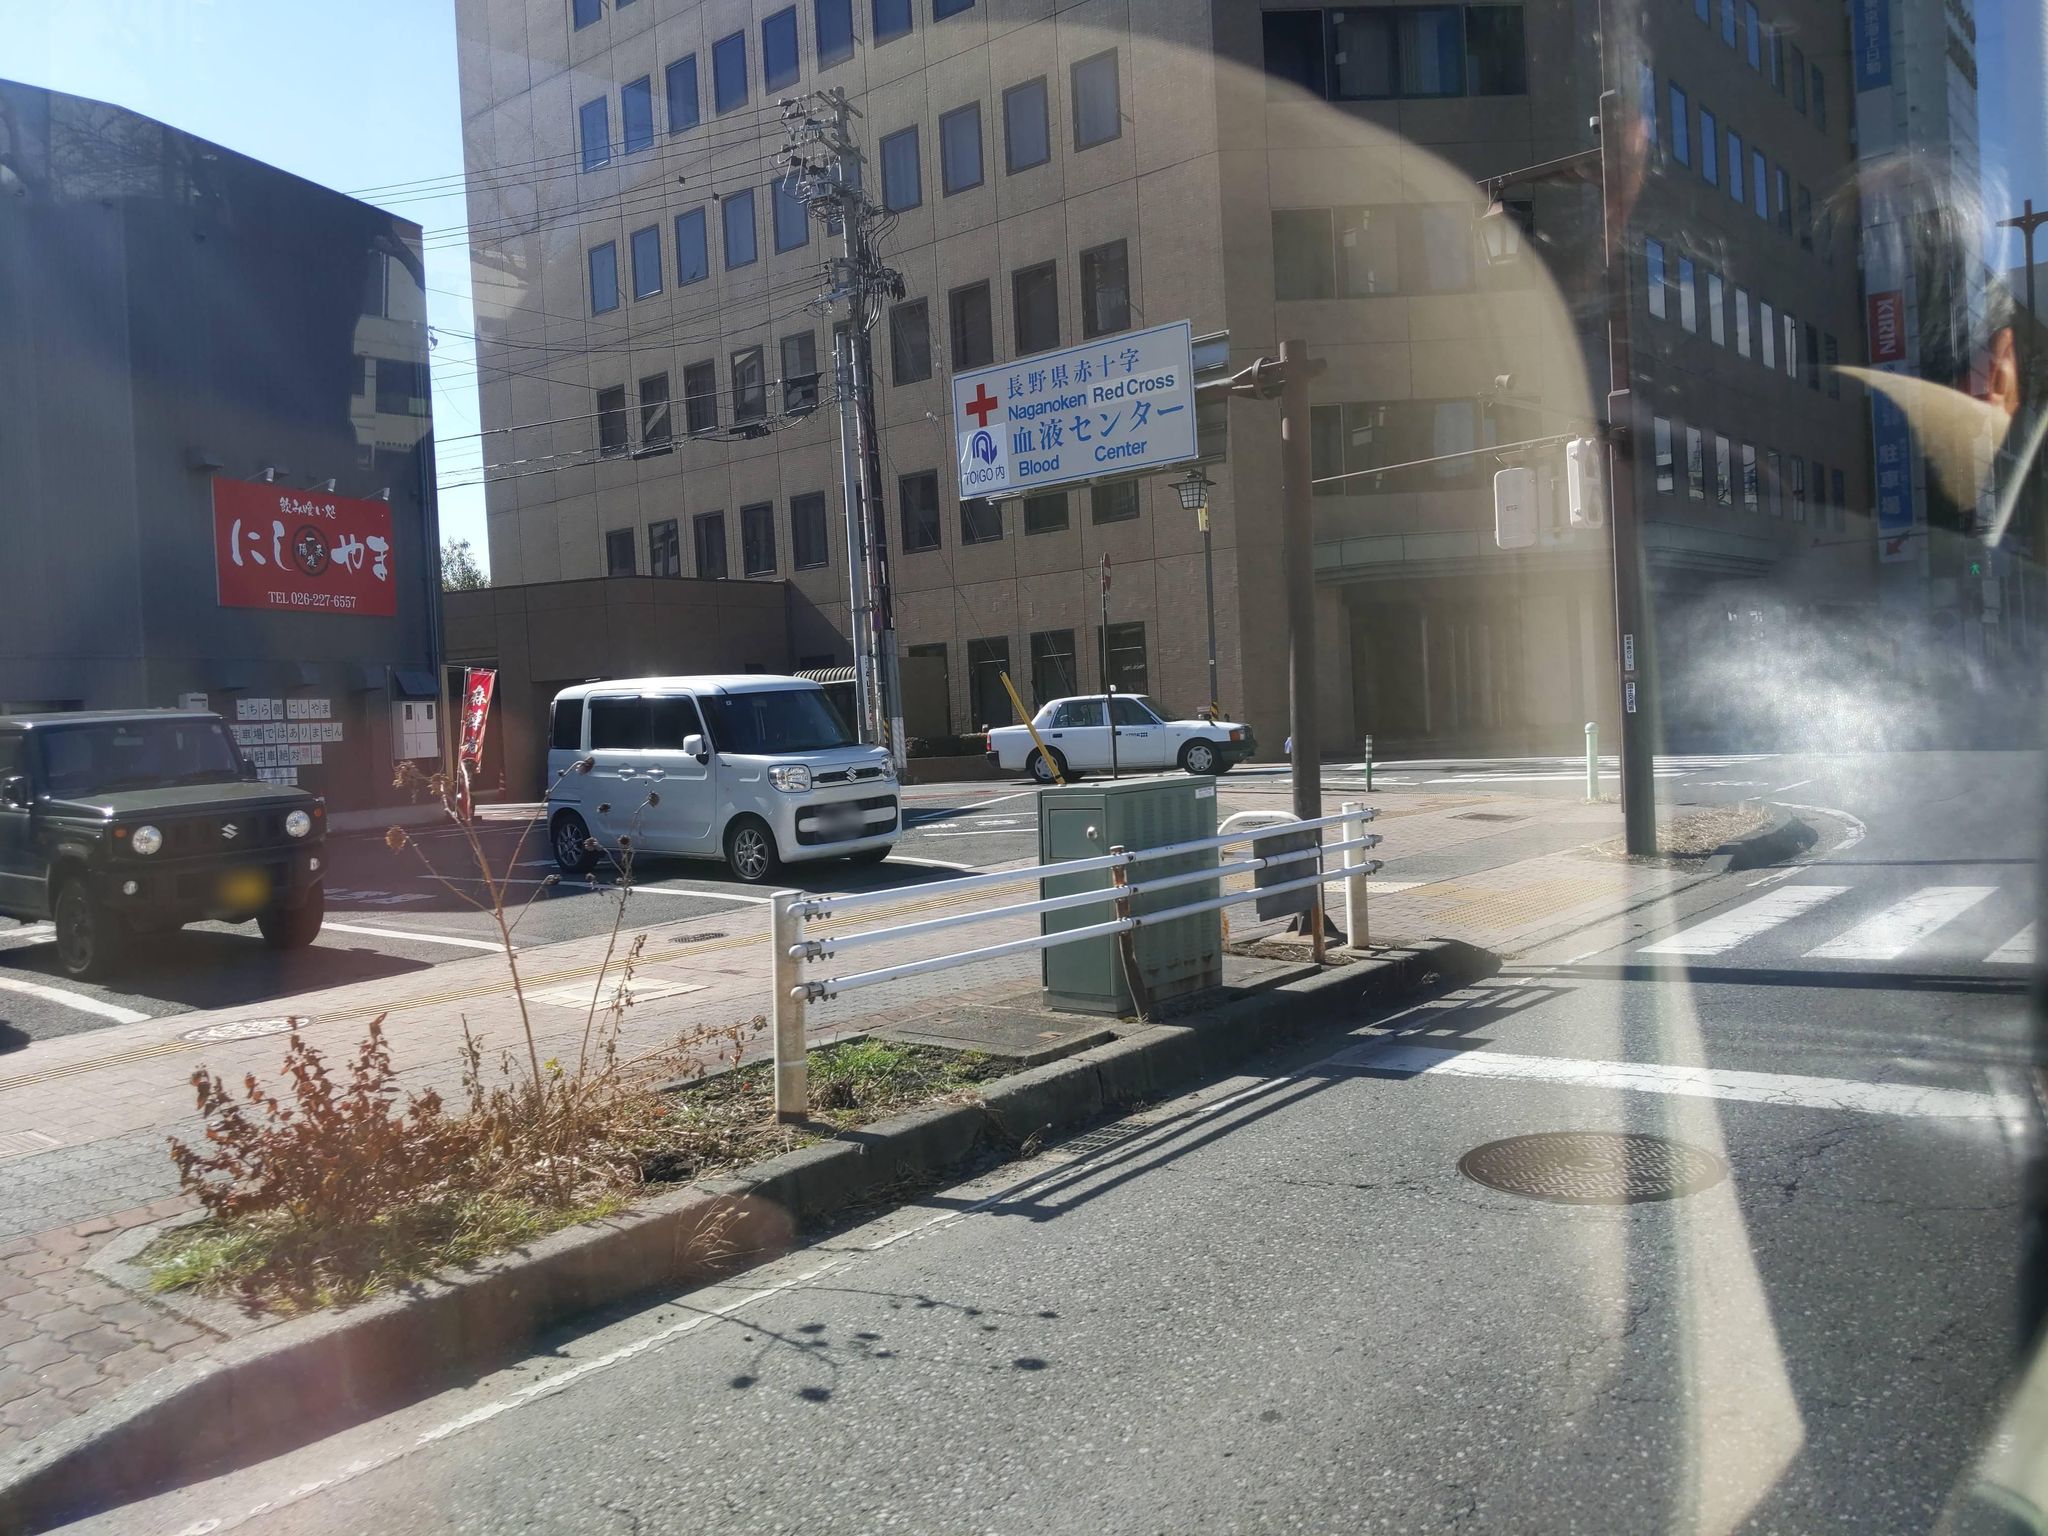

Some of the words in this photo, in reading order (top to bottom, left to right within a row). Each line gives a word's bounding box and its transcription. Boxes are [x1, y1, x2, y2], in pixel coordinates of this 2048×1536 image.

[1877, 299, 1897, 355] KIRIN
[1007, 348, 1140, 400] 長野県赤十字
[1008, 391, 1087, 421] Naganoken
[1093, 383, 1124, 404] Red
[1126, 373, 1175, 395] Cross
[1011, 400, 1185, 456] 血液センター
[1019, 454, 1060, 477] Blood
[1094, 438, 1148, 462] Center
[268, 591, 289, 604] TEL
[291, 591, 357, 609] 026-227-6557
[288, 703, 329, 715] にしやま
